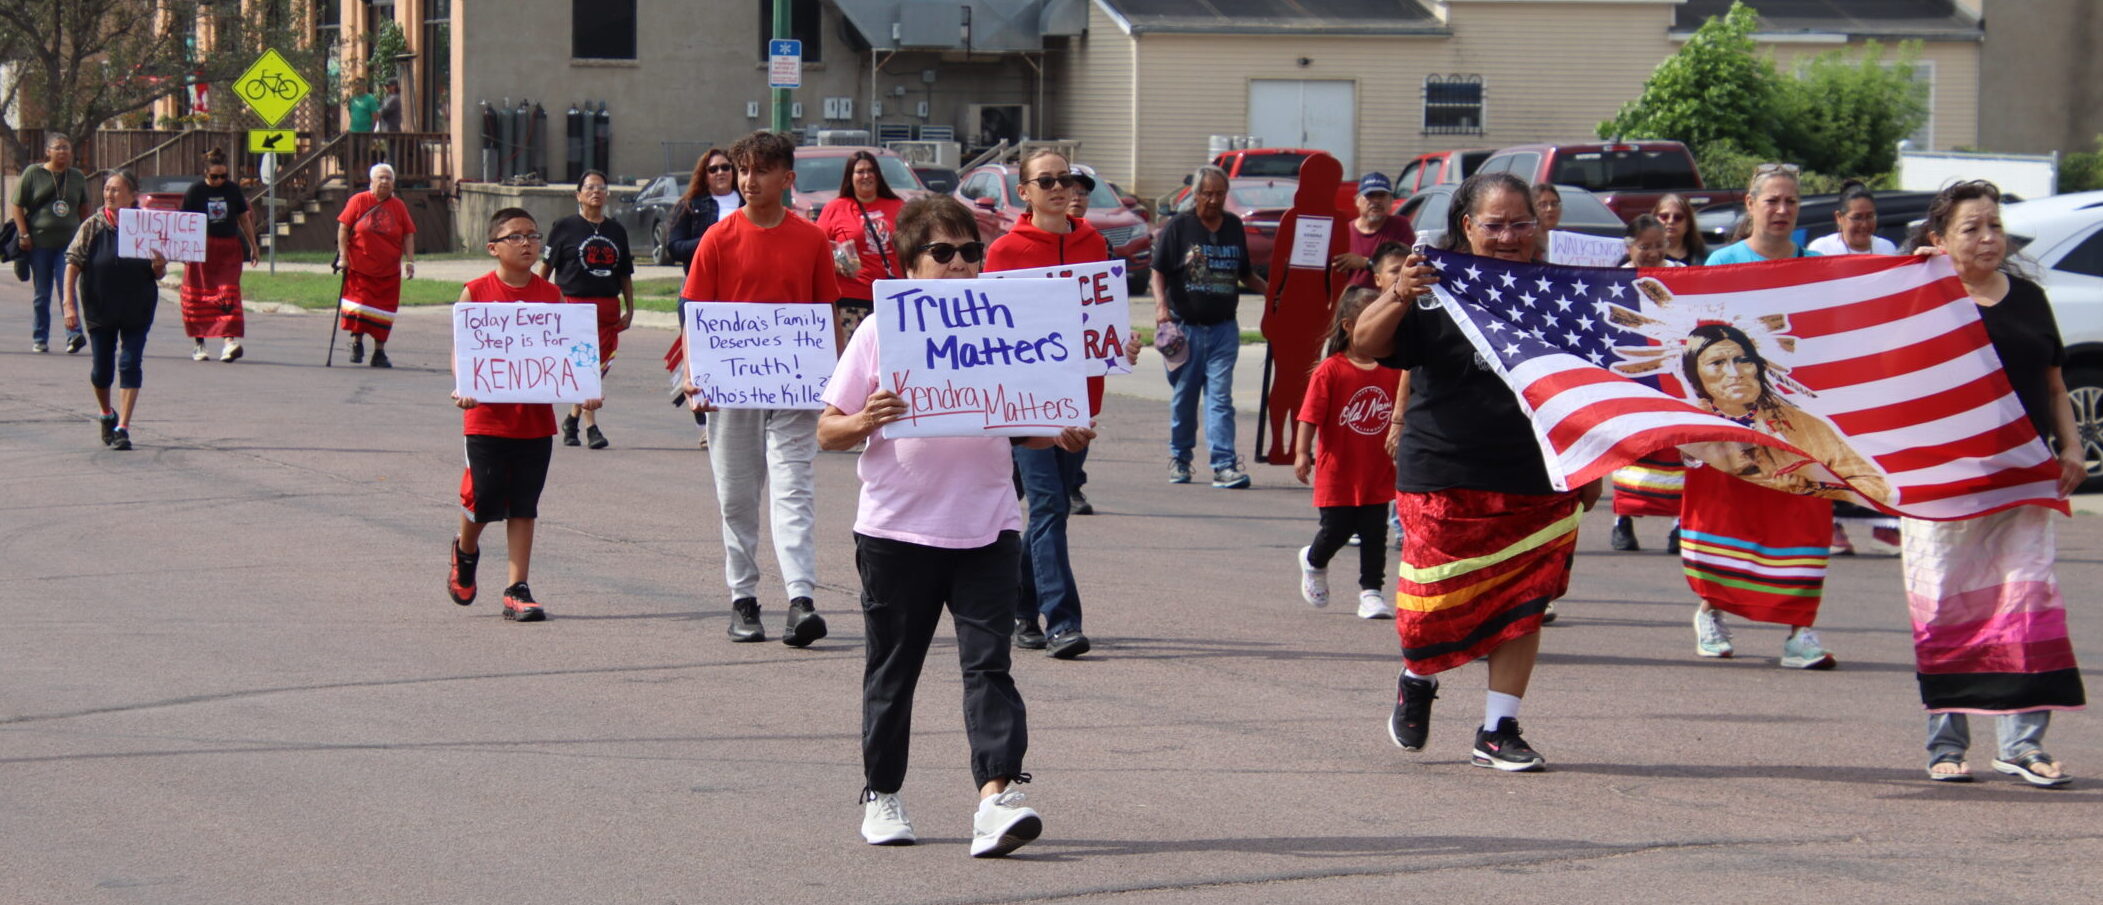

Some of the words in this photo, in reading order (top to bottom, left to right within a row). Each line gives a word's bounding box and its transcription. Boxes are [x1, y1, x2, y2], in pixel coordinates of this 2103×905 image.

[126, 211, 199, 235] JUSTICE
[461, 307, 509, 333] Today
[516, 308, 561, 334] Every
[696, 308, 769, 334] Kendra's
[774, 307, 826, 332] Family
[886, 288, 1013, 333] Truth
[471, 329, 514, 354] Step
[521, 333, 534, 348] is
[543, 330, 570, 347] for
[710, 335, 782, 350] Deserves
[793, 330, 825, 350] the
[926, 331, 1069, 370] Matters
[473, 356, 579, 398] KENDRA
[720, 353, 803, 380] Truth!
[750, 385, 777, 404] the
[780, 384, 821, 406] Kille
[892, 369, 980, 426] Kendra
[982, 383, 1080, 425] Matters
[1339, 399, 1366, 426] Old
